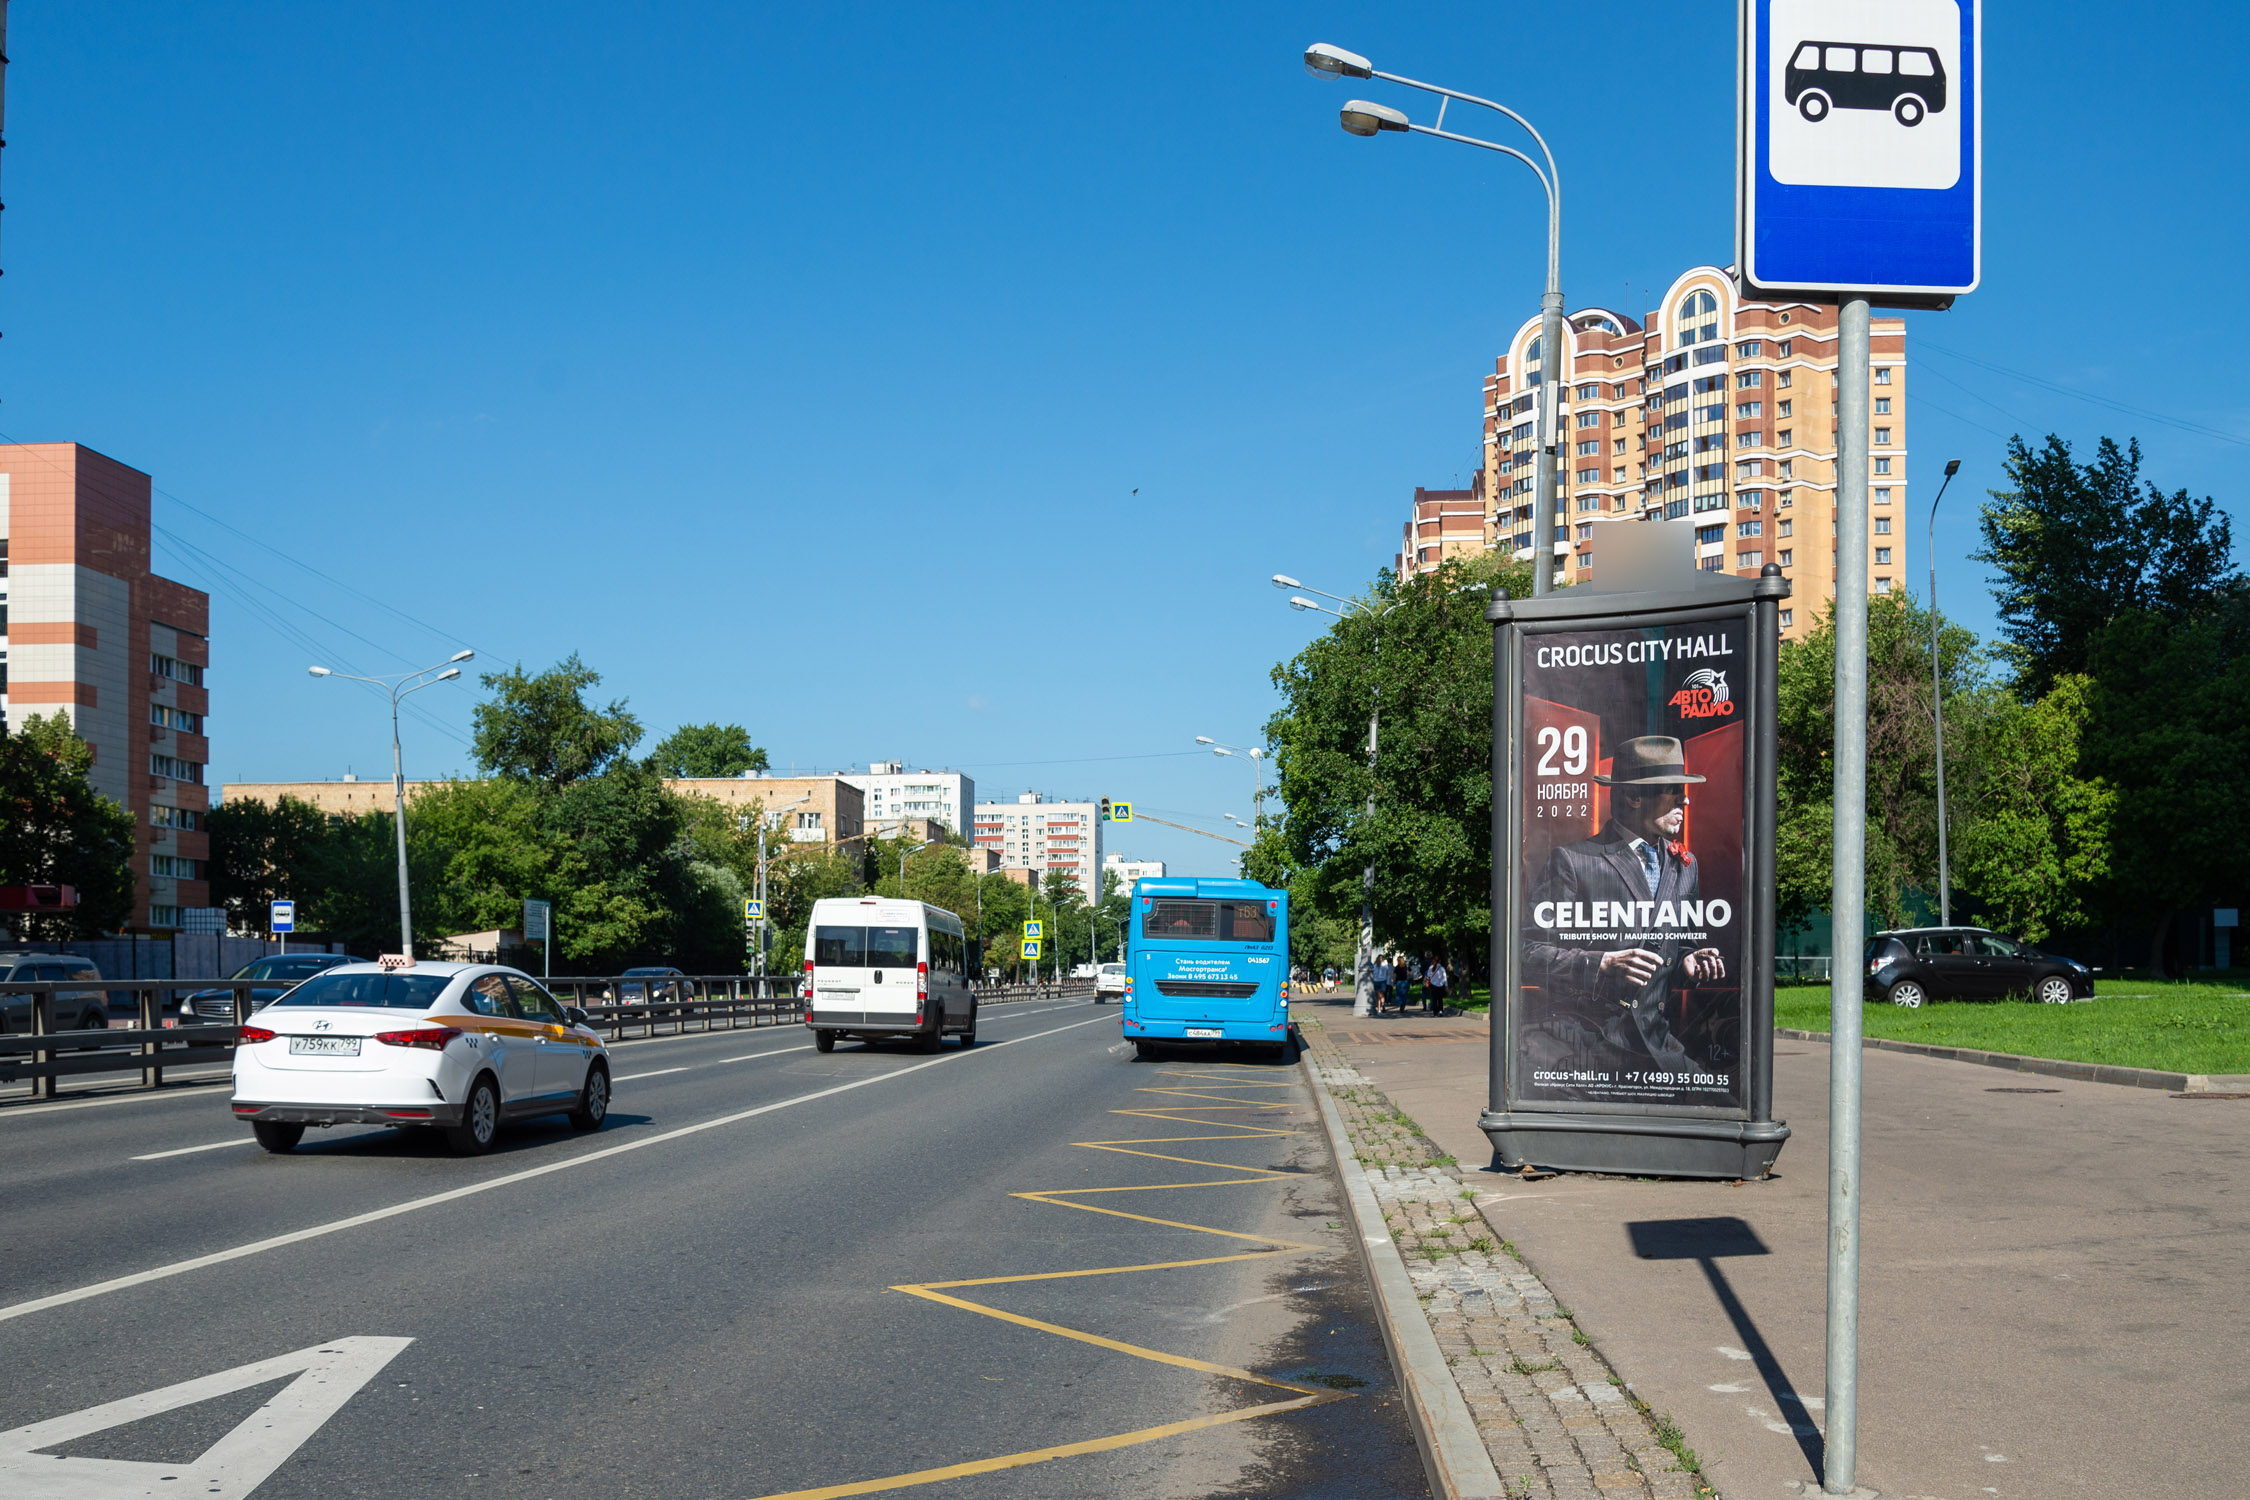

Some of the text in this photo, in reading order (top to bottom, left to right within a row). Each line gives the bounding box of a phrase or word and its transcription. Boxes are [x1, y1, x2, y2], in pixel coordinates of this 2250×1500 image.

[1536, 633, 1734, 668] CROCUS CITY HALL
[1668, 688, 1712, 706] АВТО
[1680, 700, 1735, 719] РАДИО
[1537, 725, 1588, 777] 29
[1537, 782, 1588, 800] НОЯБРЯ
[1533, 898, 1732, 929] CELENTANO
[1559, 931, 1708, 941] TRIBUTE SHOW MAURIZIO SCHWEIZER
[1707, 1044, 1729, 1061] 12+
[1533, 1070, 1729, 1086] crocus-hall.ru +7 (499) 55 000 55
